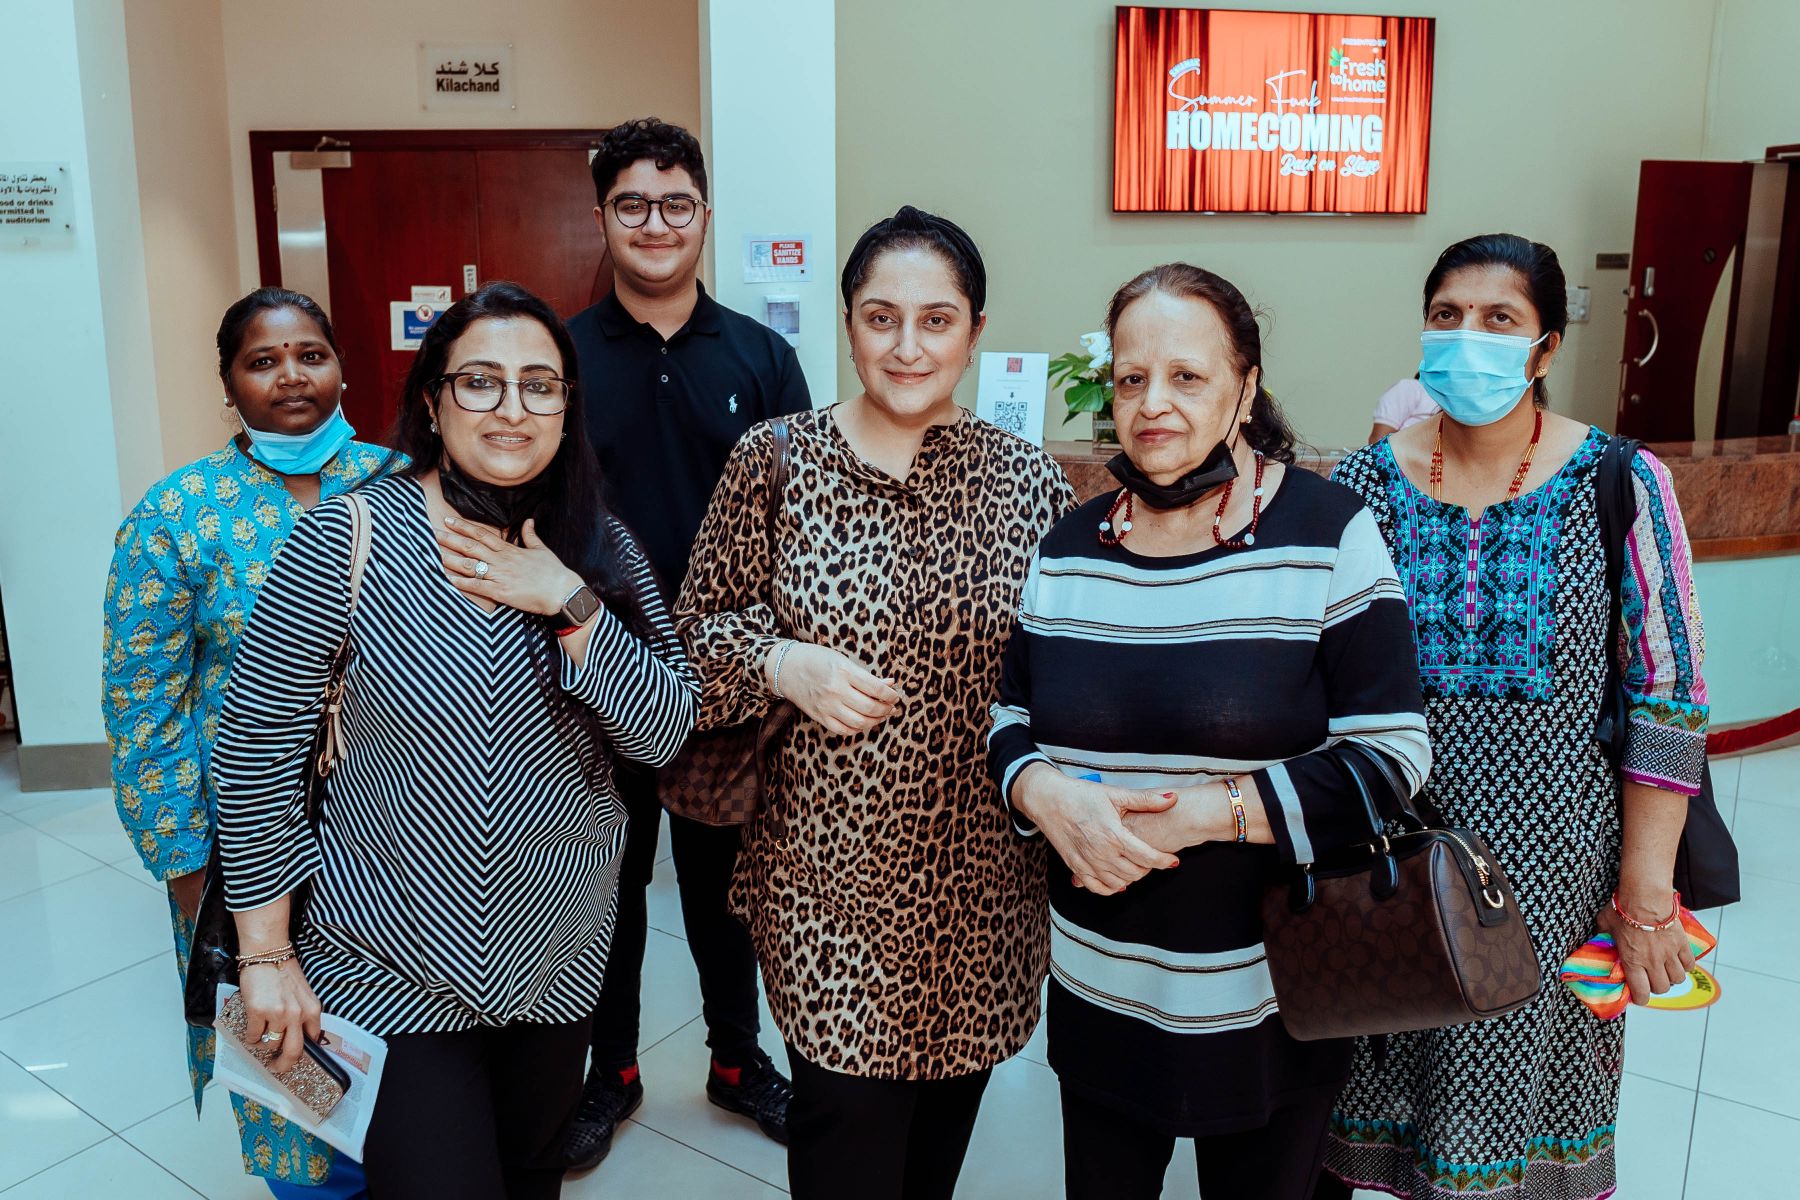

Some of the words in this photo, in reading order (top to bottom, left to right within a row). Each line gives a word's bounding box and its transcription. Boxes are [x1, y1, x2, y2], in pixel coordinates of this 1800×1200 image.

[436, 60, 468, 75] شند
[473, 61, 499, 76] كلا
[1340, 57, 1385, 76] Fresh
[436, 78, 500, 93] Kilachand
[1330, 72, 1342, 85] to
[1341, 74, 1386, 93] home
[1168, 66, 1258, 111] Summer
[1265, 70, 1322, 116] Funk
[1167, 110, 1383, 153] HOMECOMING
[1280, 153, 1318, 177] Back
[1318, 158, 1337, 172] on
[1340, 154, 1381, 178] Stage
[0, 199, 14, 207] ood
[28, 199, 54, 207] drinks
[773, 249, 802, 257] SANITIZE
[777, 256, 798, 264] HANDS
